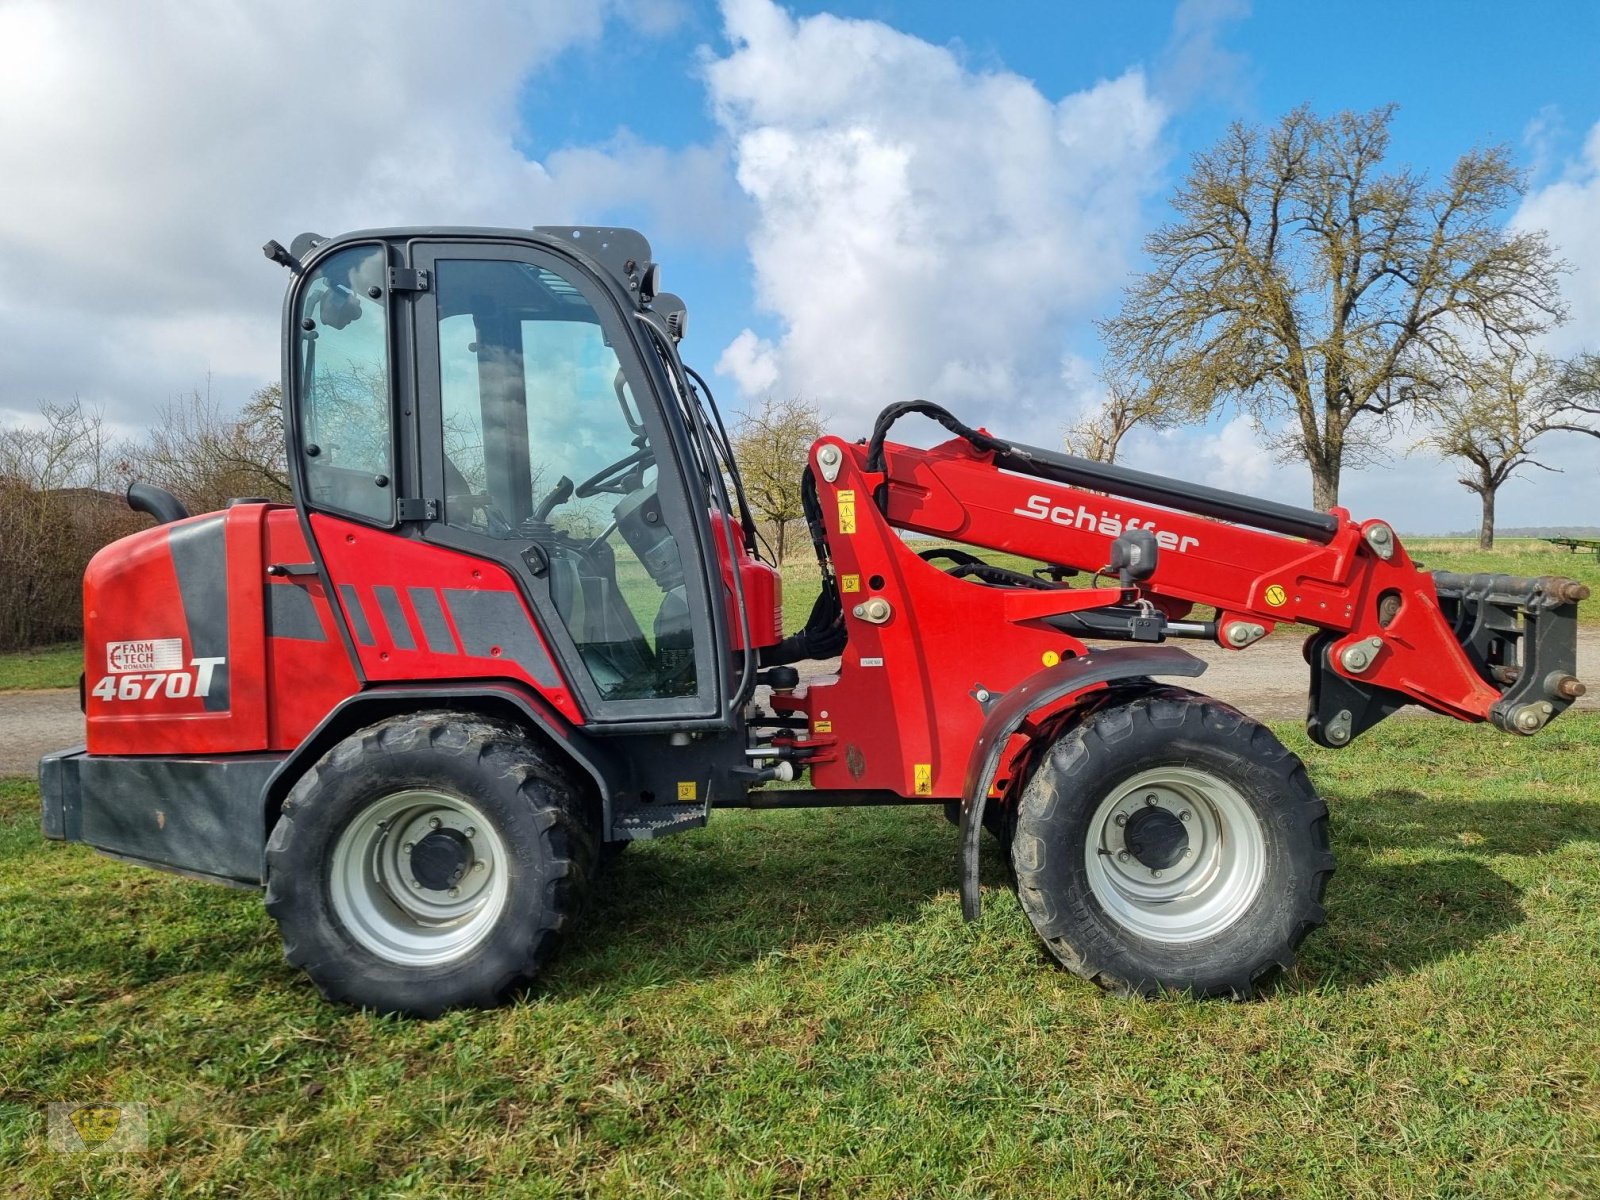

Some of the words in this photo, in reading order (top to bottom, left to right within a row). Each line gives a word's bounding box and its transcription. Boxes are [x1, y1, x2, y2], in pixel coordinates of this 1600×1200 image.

[122, 643, 154, 654] FARM
[123, 653, 154, 664] TECH
[91, 656, 226, 702] 4670T
